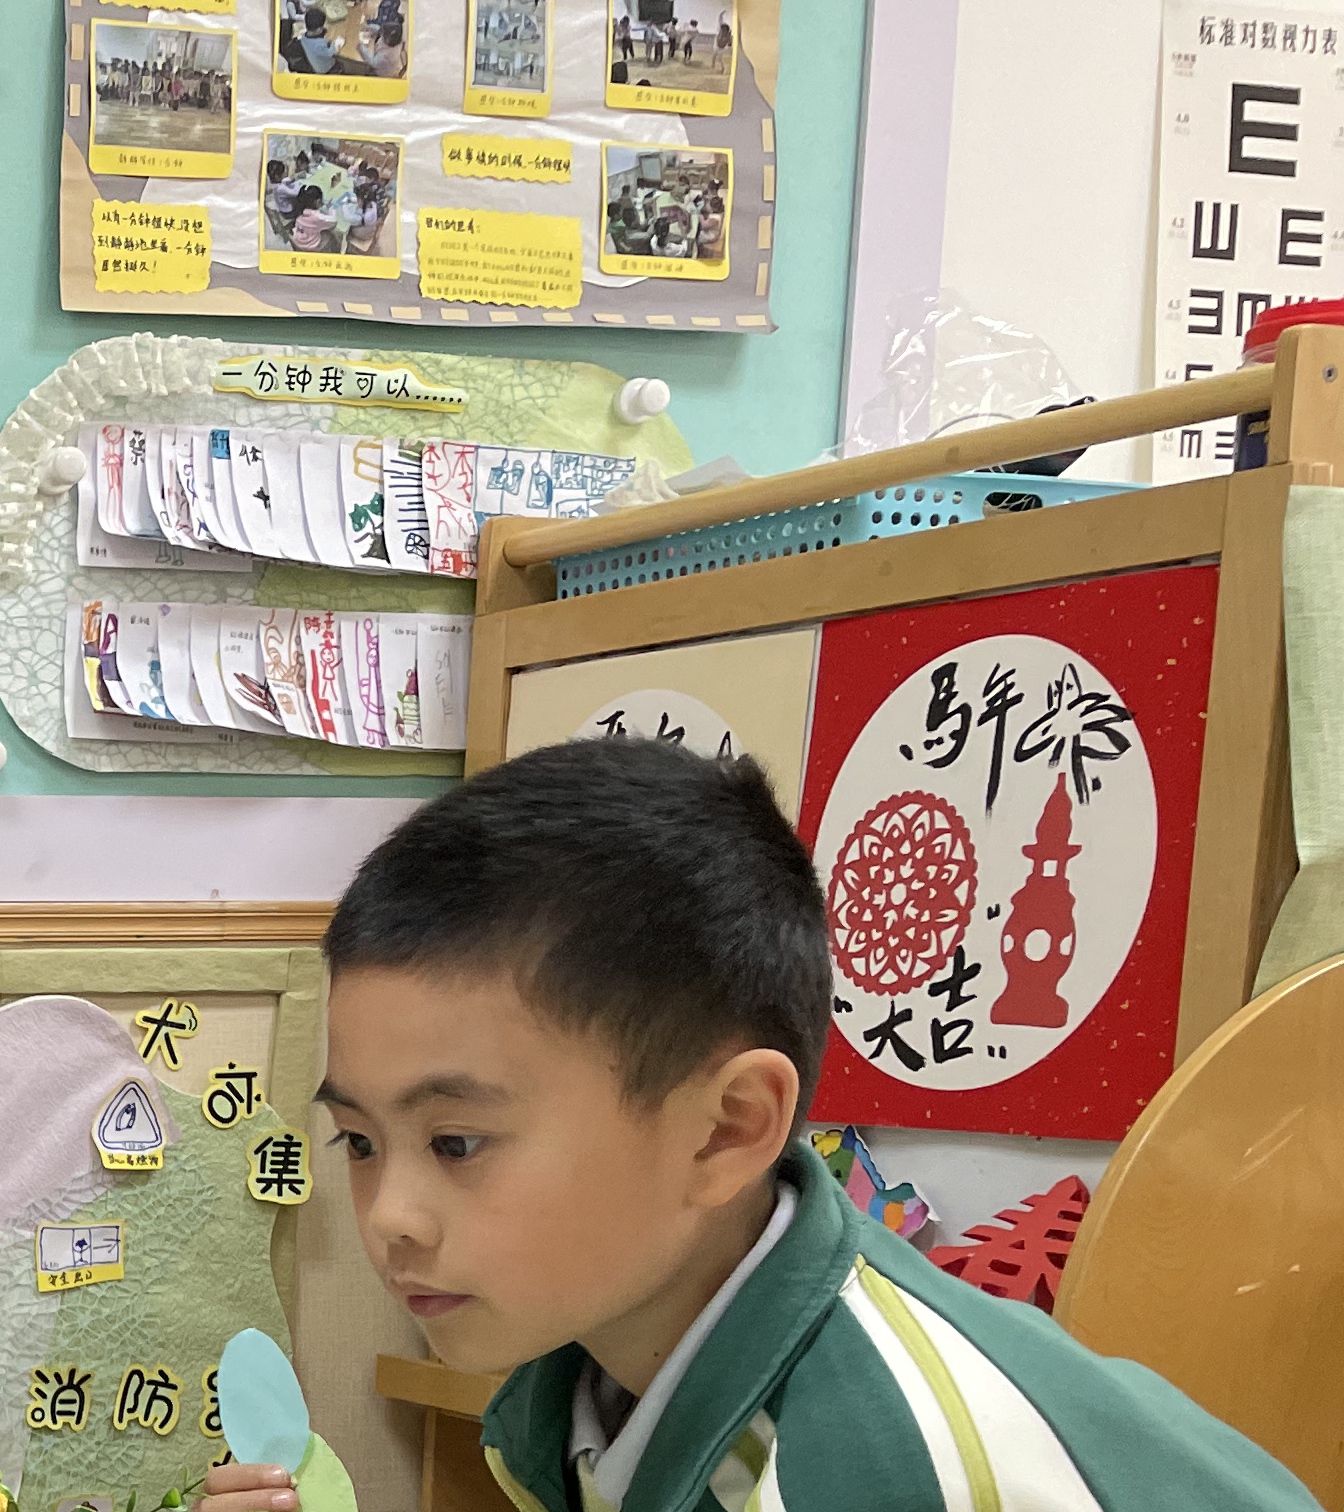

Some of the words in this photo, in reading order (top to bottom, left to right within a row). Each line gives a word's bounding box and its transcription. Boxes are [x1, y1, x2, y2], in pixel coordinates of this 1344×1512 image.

[1199, 16, 1338, 55] 标准对数视力表
